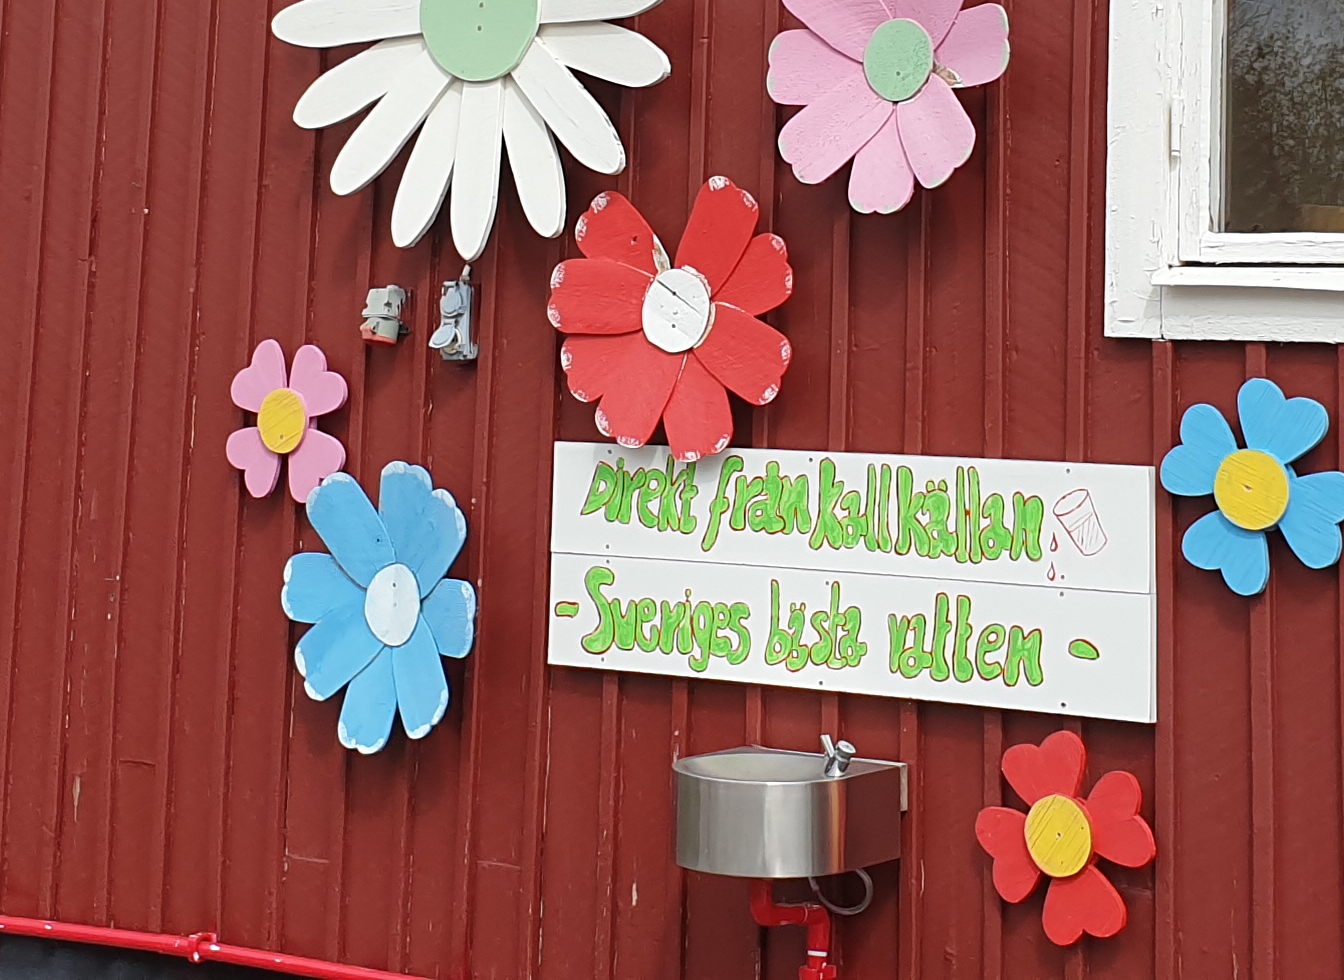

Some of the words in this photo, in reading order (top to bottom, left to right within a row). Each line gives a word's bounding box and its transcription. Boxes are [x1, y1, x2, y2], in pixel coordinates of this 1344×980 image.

[580, 454, 699, 534] Direkt
[701, 455, 811, 551] från
[581, 566, 751, 672] Sveriges
[764, 579, 868, 672] bästa
[888, 592, 1044, 687] vatten
